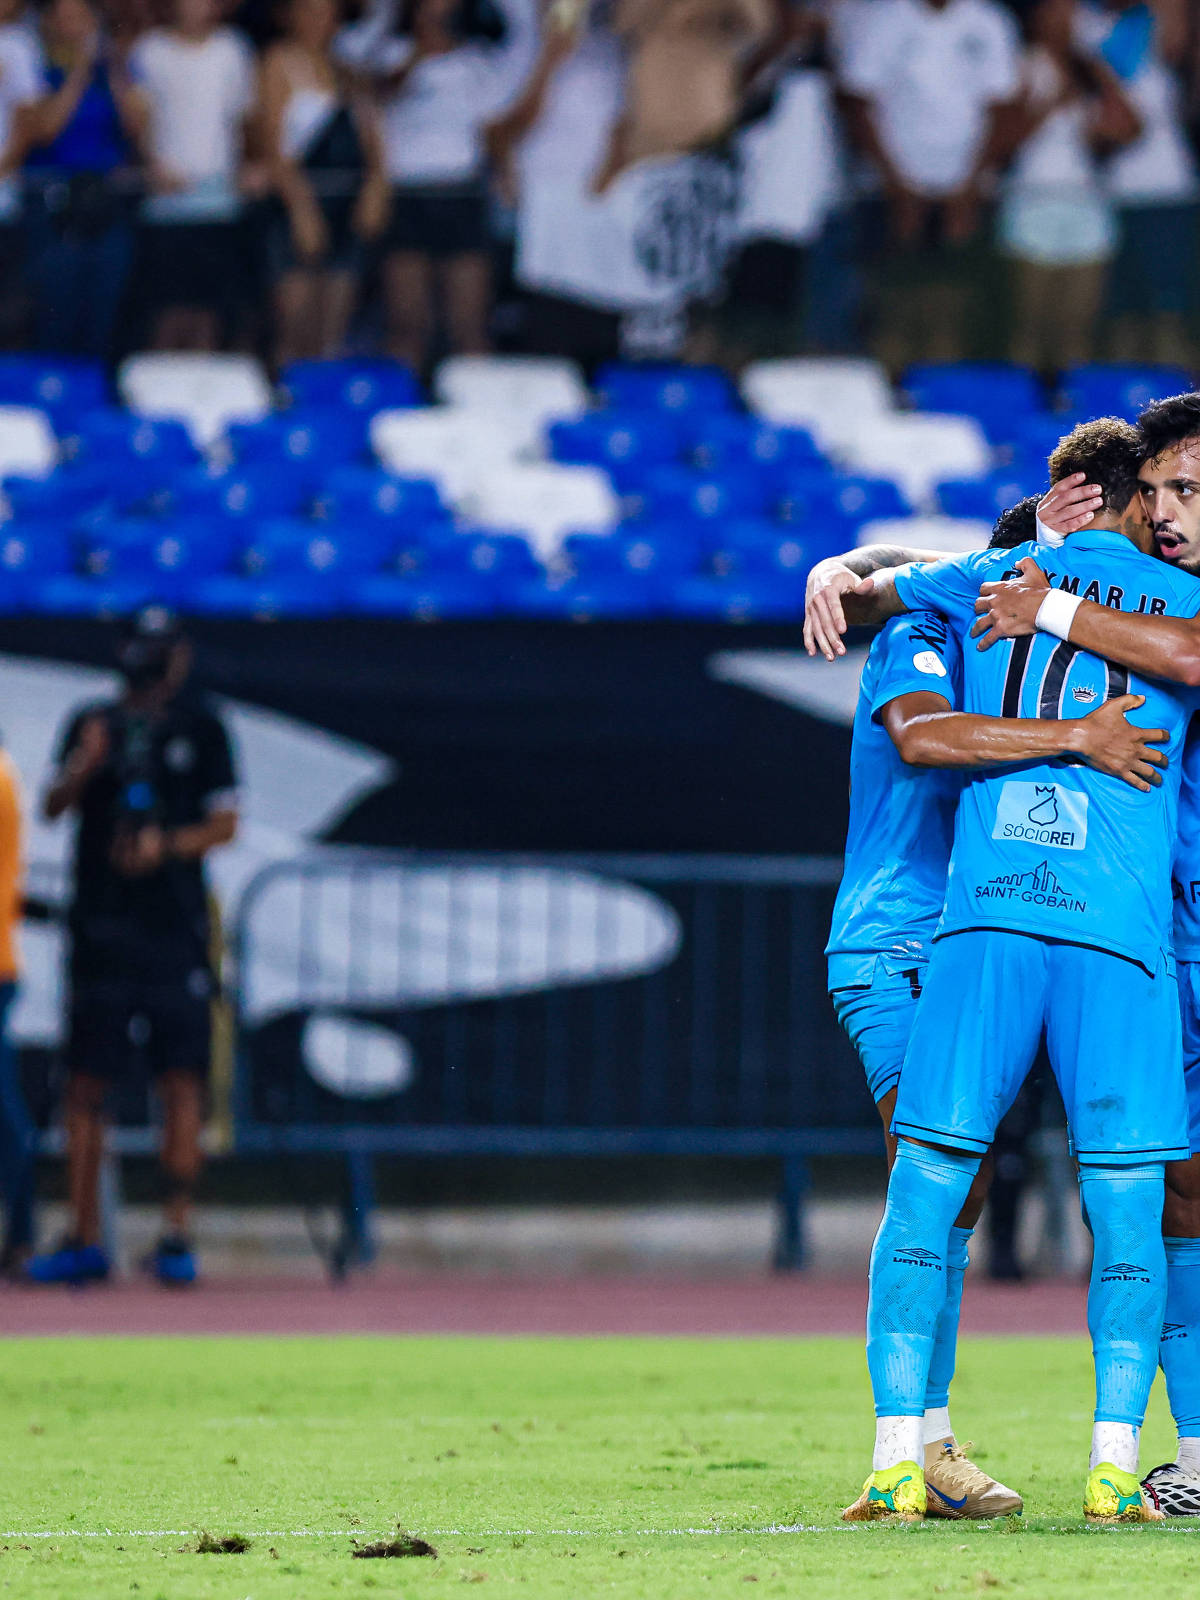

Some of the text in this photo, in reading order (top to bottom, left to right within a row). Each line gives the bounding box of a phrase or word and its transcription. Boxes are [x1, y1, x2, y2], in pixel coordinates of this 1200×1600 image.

[1003, 823, 1075, 846] SÓCIOREI
[975, 886, 1087, 913] SAINT-GOBAIN
[892, 1257, 942, 1271] umbro
[1100, 1274, 1150, 1284] umbro
